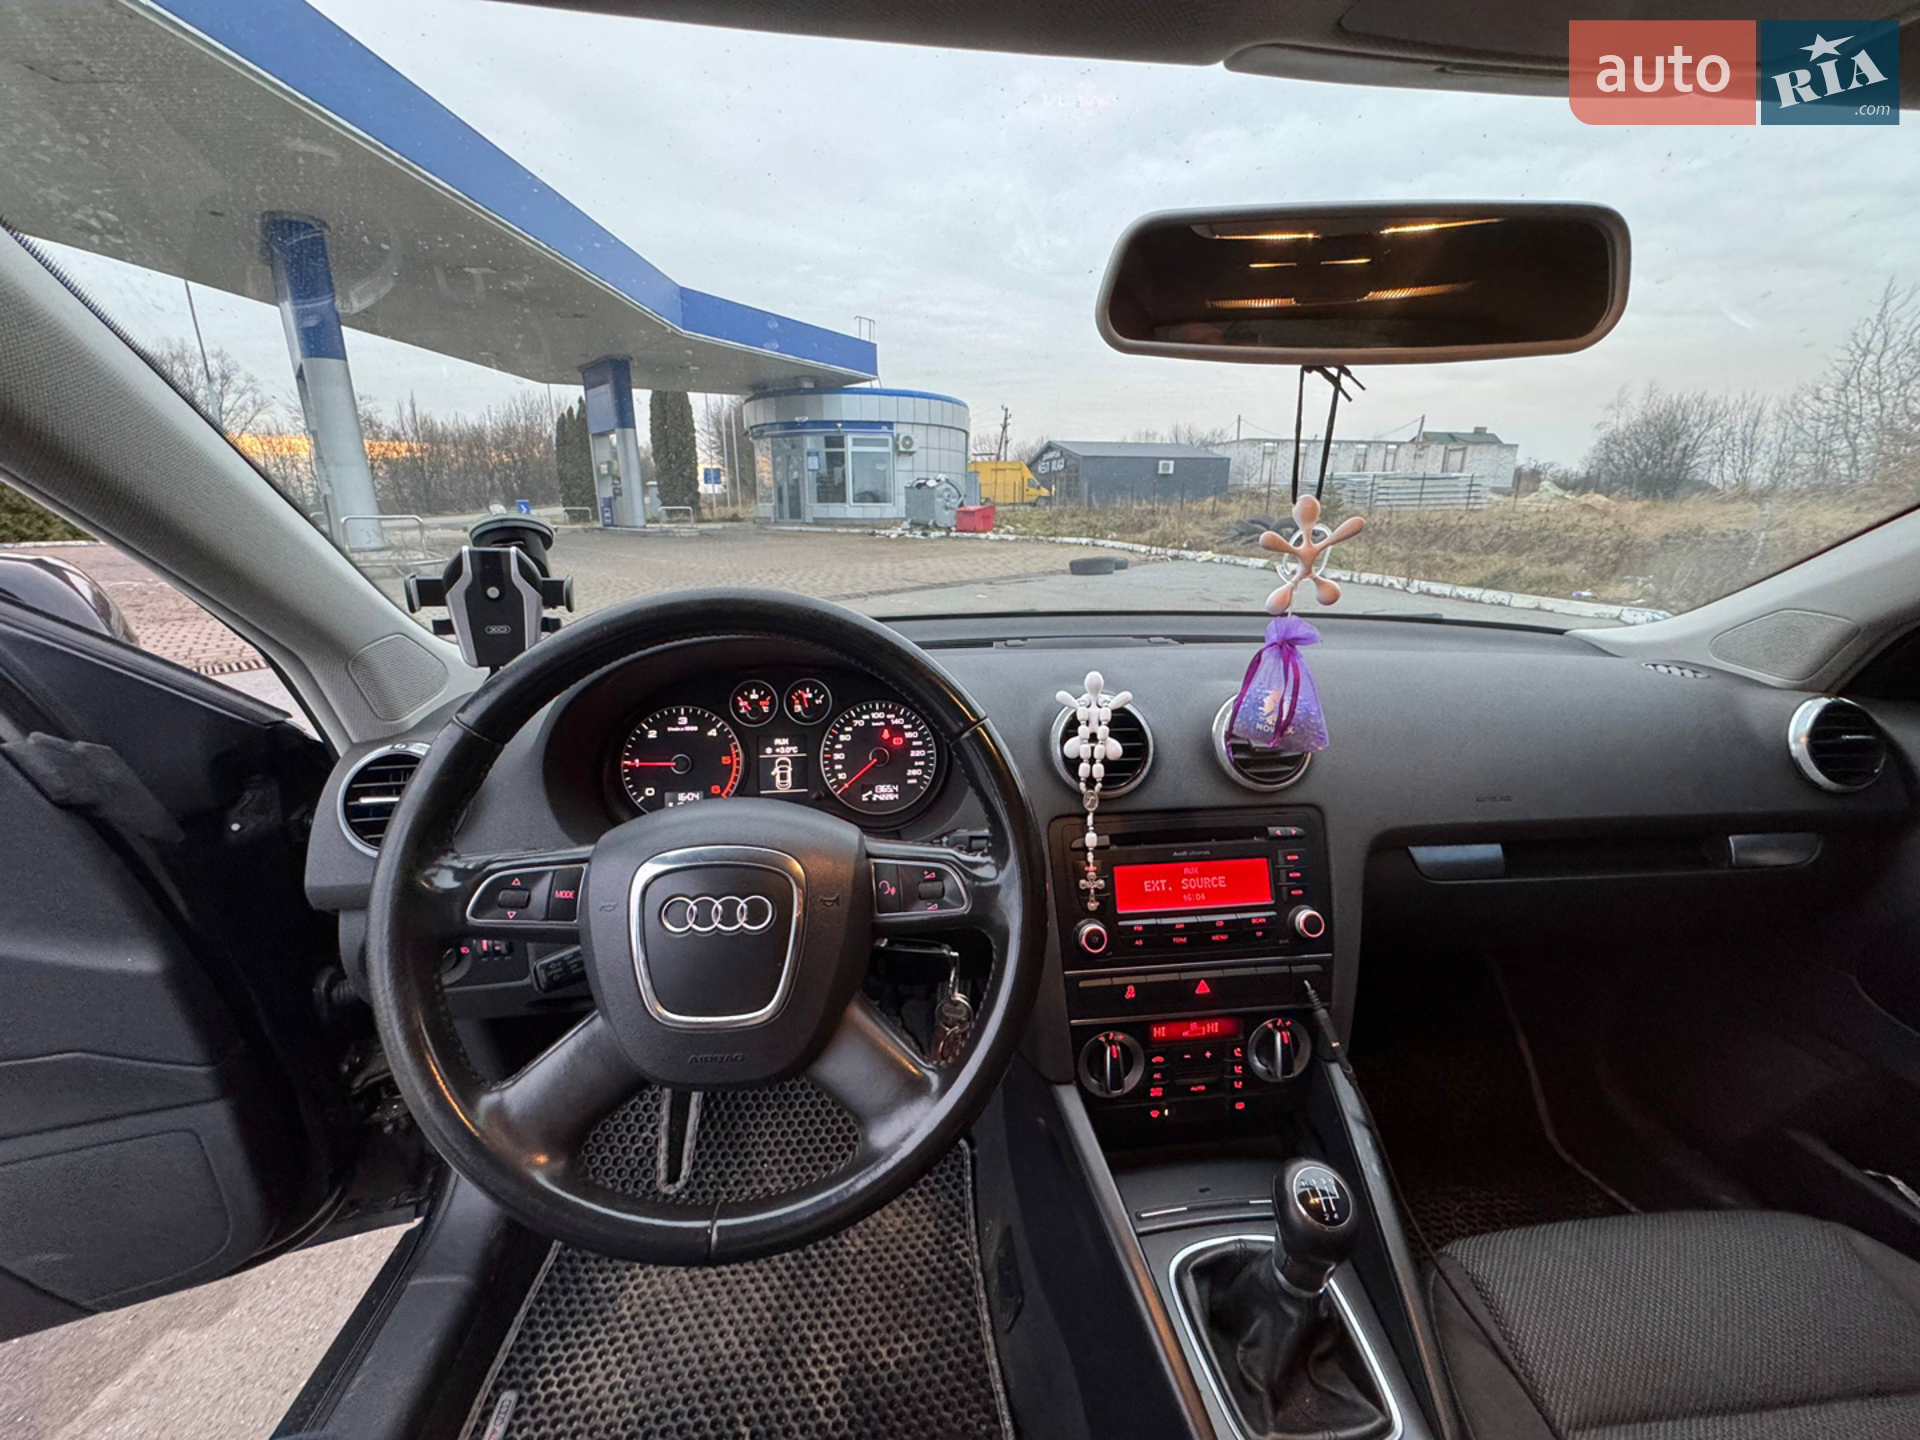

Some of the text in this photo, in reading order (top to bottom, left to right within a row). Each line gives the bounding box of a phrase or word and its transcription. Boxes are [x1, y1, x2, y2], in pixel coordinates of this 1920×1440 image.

[677, 716, 688, 725] 3
[647, 729, 658, 739] 2
[707, 728, 718, 737] 4
[837, 772, 847, 780] 10
[645, 787, 655, 797] 0
[711, 785, 721, 794] 6
[1144, 876, 1227, 892] EXT. SOURCE
[554, 889, 576, 900] MODE
[1251, 917, 1267, 925] SCAN
[1153, 1026, 1166, 1038] HI
[1206, 1021, 1219, 1033] HI
[688, 1052, 745, 1065] AIRBAG
[1190, 1084, 1207, 1092] AUTO
